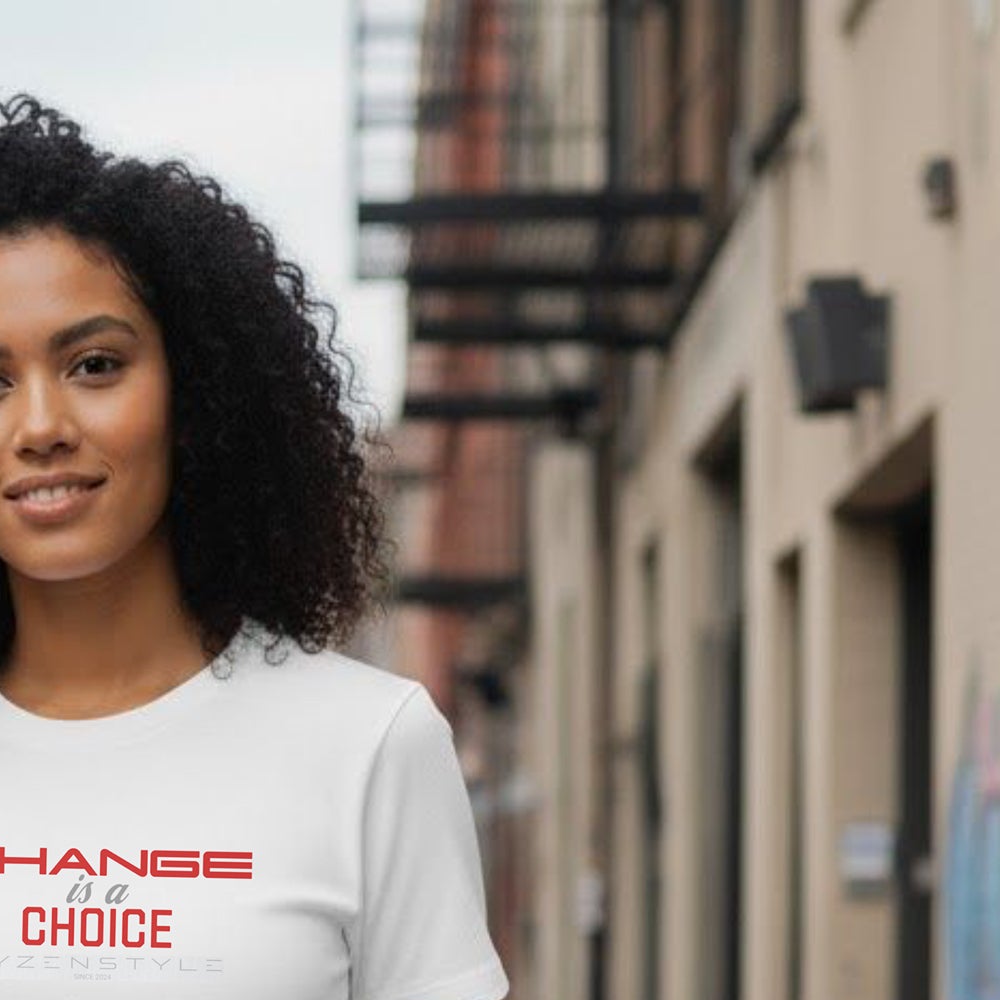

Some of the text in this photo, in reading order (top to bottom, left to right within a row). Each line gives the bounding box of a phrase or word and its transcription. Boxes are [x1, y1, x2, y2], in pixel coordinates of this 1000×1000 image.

[65, 874, 130, 905] is a
[21, 906, 173, 949] CHOICE
